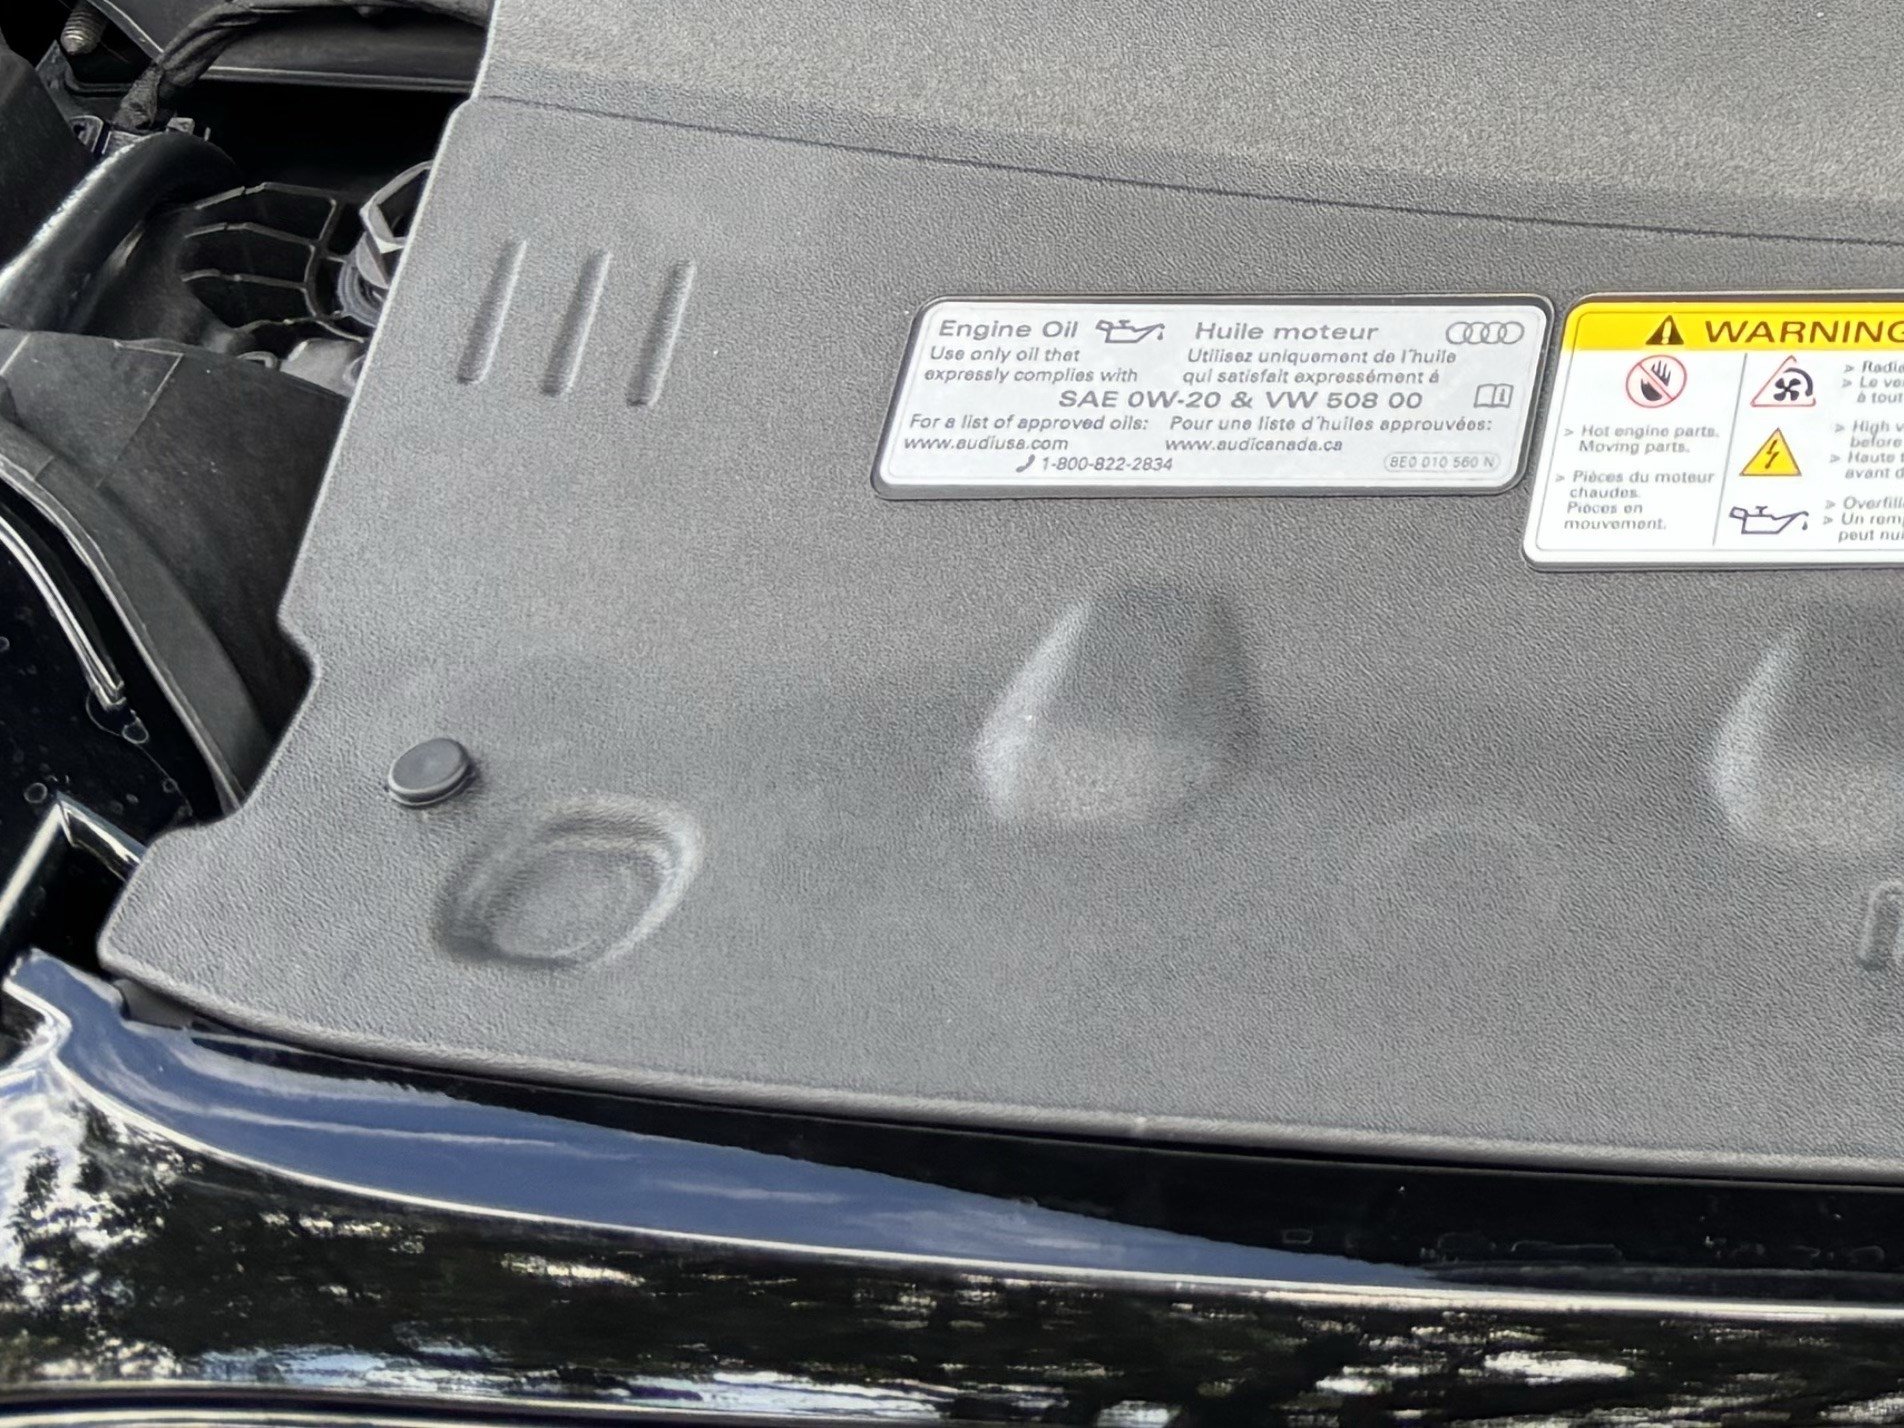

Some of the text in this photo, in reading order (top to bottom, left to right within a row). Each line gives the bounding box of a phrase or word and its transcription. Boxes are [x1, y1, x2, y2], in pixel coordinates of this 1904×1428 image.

[938, 319, 1079, 340] Engine Oil
[1195, 322, 1379, 340] Huile moteur
[929, 346, 1080, 364] Use only oil that
[1187, 348, 1252, 364] Utilisez
[1258, 349, 1368, 366] uniquement
[1373, 350, 1395, 364] de
[924, 367, 1138, 385] expressly complies with
[1182, 369, 1212, 385] qui
[1217, 368, 1288, 384] satisfait
[1294, 369, 1424, 386] expressément
[1058, 390, 1423, 410] SAE 0W-20 & VW 508 00
[909, 413, 1150, 433] For a list of approved oils:
[1169, 416, 1213, 431] Pour
[1218, 418, 1252, 431] une
[1258, 416, 1296, 431] liste
[1380, 417, 1492, 434] approuvées:
[1580, 424, 1720, 439] Hot engine parts.
[1851, 419, 1891, 437] High
[904, 435, 1069, 451] www.audiusa.com
[1164, 437, 1343, 452] www.audicanada.ca
[1579, 440, 1690, 456] Moving parts.
[1042, 457, 1174, 472] 1-800-822-2834
[1422, 456, 1448, 468] 010
[1628, 471, 1649, 483] du
[1655, 471, 1715, 484] moteur
[1623, 503, 1643, 514] en
